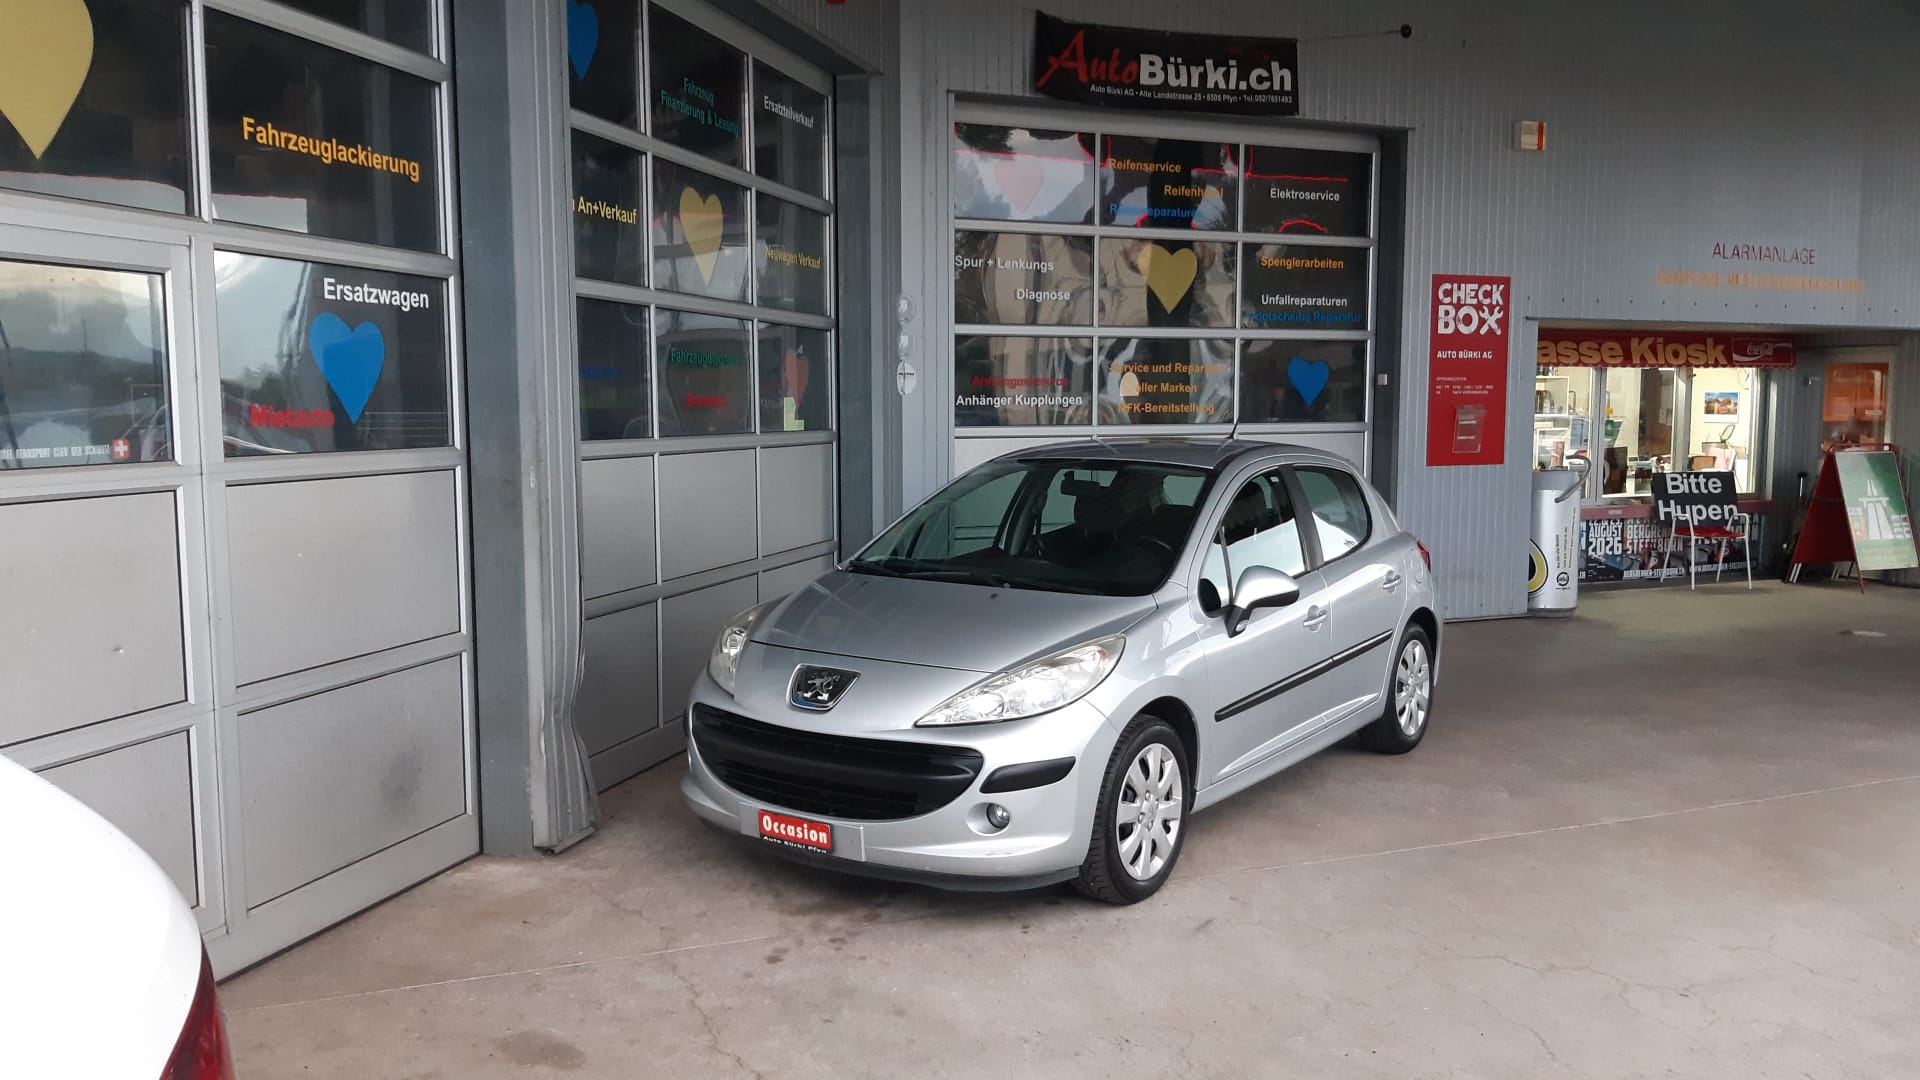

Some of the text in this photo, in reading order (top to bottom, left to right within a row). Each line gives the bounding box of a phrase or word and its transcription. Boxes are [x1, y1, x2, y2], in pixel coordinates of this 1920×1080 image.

[683, 77, 715, 107] Fahrzeug
[1090, 84, 1105, 93] Auto
[1106, 85, 1122, 96] Bürki
[1124, 88, 1134, 97] AG
[1139, 89, 1152, 98] Alte
[1153, 90, 1192, 101] Landstrasse
[660, 90, 705, 125] Finanzierung
[707, 112, 713, 125] &
[764, 95, 814, 129] Ersatzteilverkauf
[242, 116, 420, 182] Fahrzeuglackierung
[1108, 158, 1182, 173] Reifenservice
[1270, 187, 1340, 202] Elektroservice
[578, 195, 637, 225] An+Verkauf
[954, 255, 1055, 273] Spur + Lenkungs
[1261, 255, 1344, 270] Spenglerarbeiten
[1711, 242, 1816, 265] ALARMANLAGE
[323, 277, 430, 312] Ersatzwagen
[1016, 288, 1071, 303] Diagnose
[1261, 294, 1348, 308] Unfallreparaturen
[1438, 282, 1504, 305] CHECK
[1437, 305, 1504, 335] BOX
[1436, 350, 1493, 359] AUTO BÜRKI AG
[1537, 338, 1624, 365] asse
[1631, 336, 1728, 366] Kiosk
[1152, 362, 1173, 373] und
[1160, 383, 1197, 393] Marken
[956, 394, 1082, 408] Anhänger Kupplungen
[250, 404, 335, 428] Mietauto
[1665, 473, 1722, 495] Bitte
[1658, 500, 1738, 526] Hupen
[1588, 524, 1622, 538] AUGUST
[1588, 537, 1622, 556] 2026
[762, 815, 828, 844] Occasion
